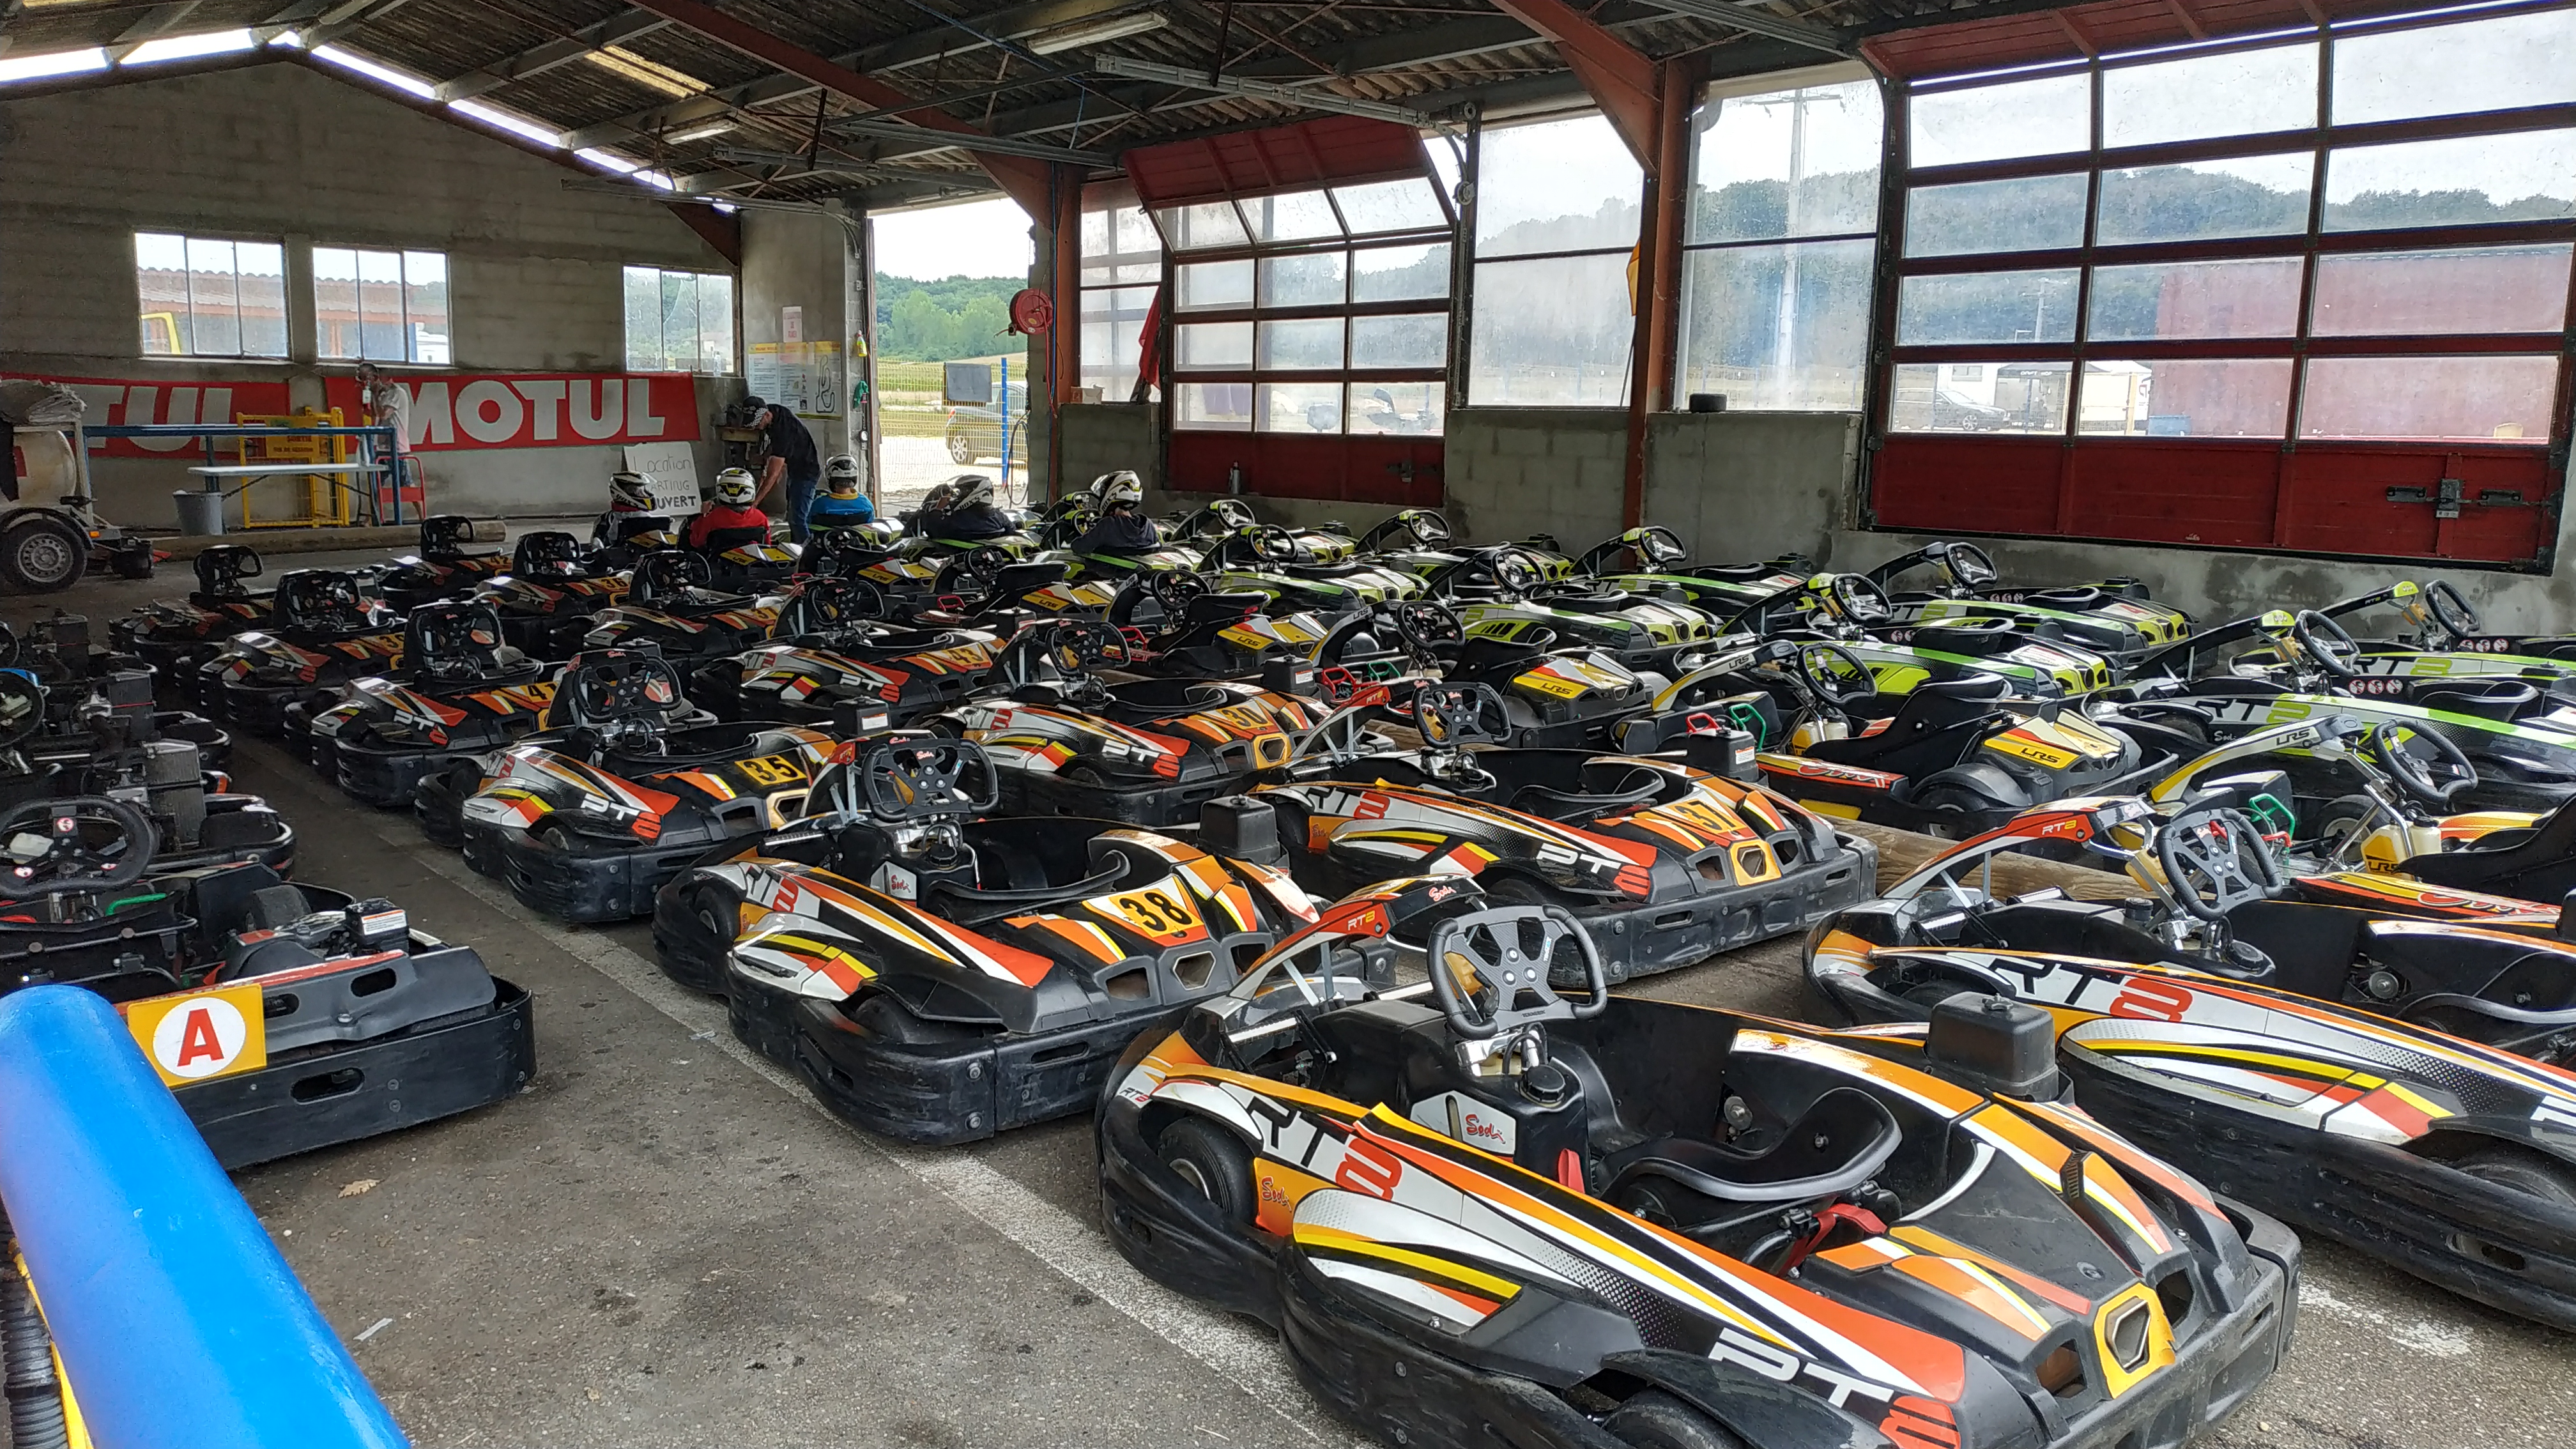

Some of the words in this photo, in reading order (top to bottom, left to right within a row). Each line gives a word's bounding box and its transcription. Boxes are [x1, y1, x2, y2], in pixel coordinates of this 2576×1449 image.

[63, 385, 240, 452] TUL
[400, 379, 665, 445] MOTUL
[650, 480, 690, 491] ARTING
[656, 494, 696, 510] UVERT
[601, 578, 629, 588] 36
[1353, 608, 1368, 619] LRS
[1237, 636, 1262, 647] LRS
[947, 647, 984, 663] 43
[1728, 655, 1749, 669] LRS
[1541, 682, 1573, 696] LRS
[1224, 705, 1269, 729] 30
[2194, 698, 2312, 723] RT8
[2276, 728, 2311, 746] LRS
[2020, 746, 2061, 764] LRS
[742, 754, 799, 782] 35
[1305, 786, 1391, 819] RT8
[2041, 819, 2078, 836] RT8
[1428, 885, 1457, 903] Sodi
[1119, 891, 1193, 933] 38
[1347, 908, 1376, 931] RT8
[1988, 957, 2193, 1022] RT8
[177, 1008, 224, 1068] A
[1119, 1086, 1151, 1105] RT8
[1465, 1113, 1508, 1144] Sodi
[1245, 1095, 1403, 1202] RT8
[1261, 1176, 1292, 1213] Sodi
